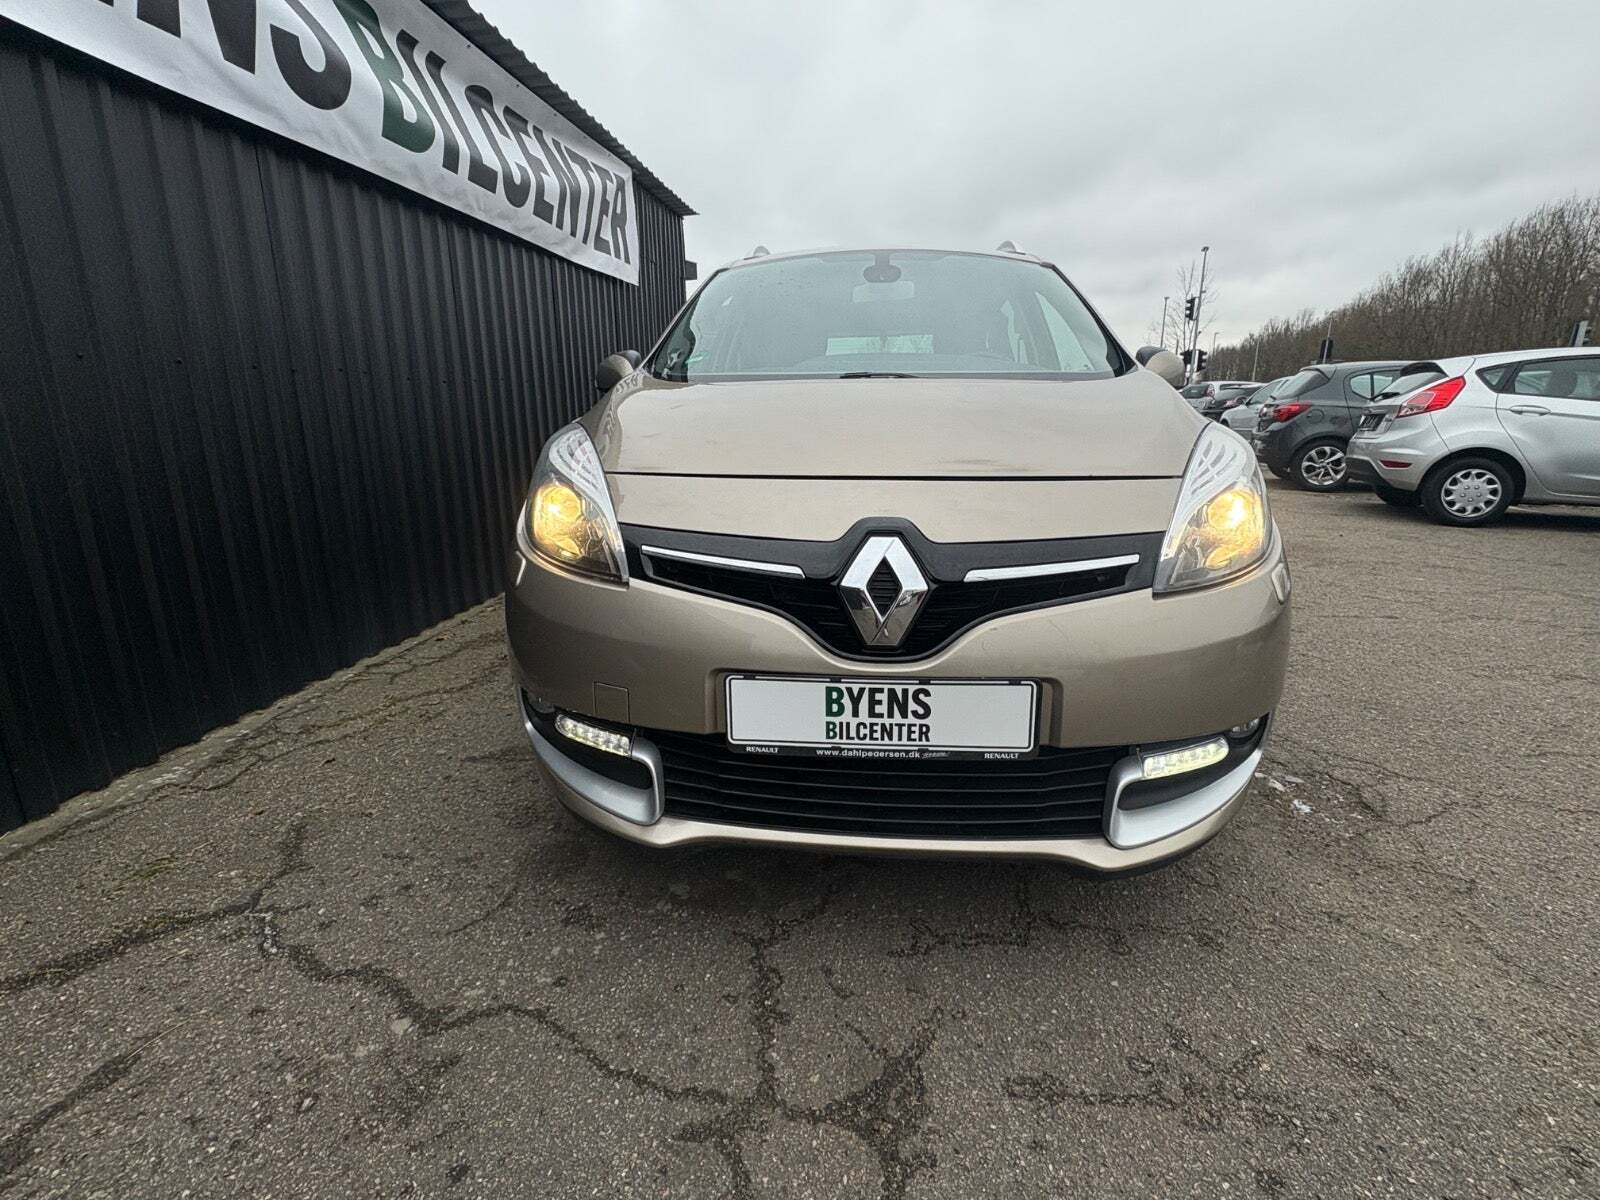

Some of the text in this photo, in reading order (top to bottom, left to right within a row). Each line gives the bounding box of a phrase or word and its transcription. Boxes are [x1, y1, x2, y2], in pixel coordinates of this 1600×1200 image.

[332, 0, 632, 265] BILCENTER
[825, 686, 932, 720] BYENS
[825, 721, 931, 742] BILCENTER
[746, 746, 779, 754] RENAULT
[984, 752, 1020, 760] RENAULT
